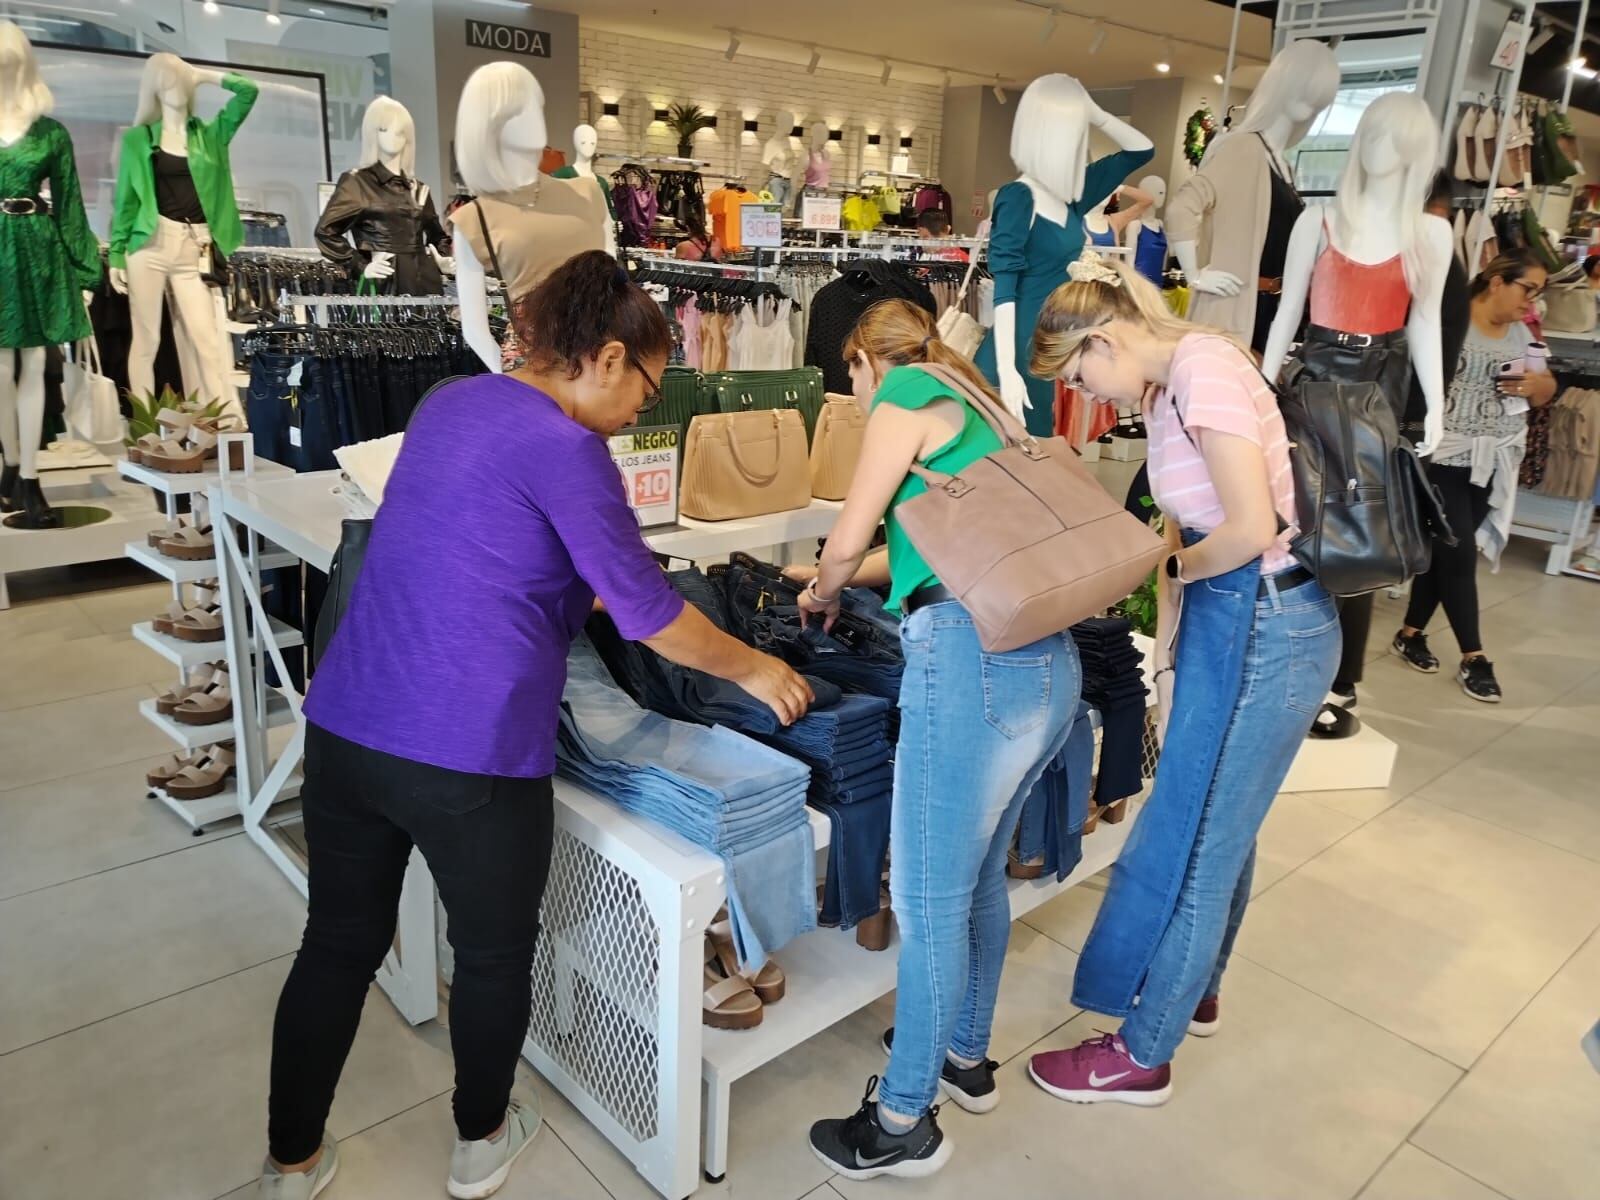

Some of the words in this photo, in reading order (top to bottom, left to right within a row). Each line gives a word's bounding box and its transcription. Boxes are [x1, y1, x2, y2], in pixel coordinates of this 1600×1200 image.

[472, 22, 545, 55] MODA
[633, 431, 678, 450] NEGRO
[621, 457, 639, 468] LOS
[641, 453, 671, 465] JEANS
